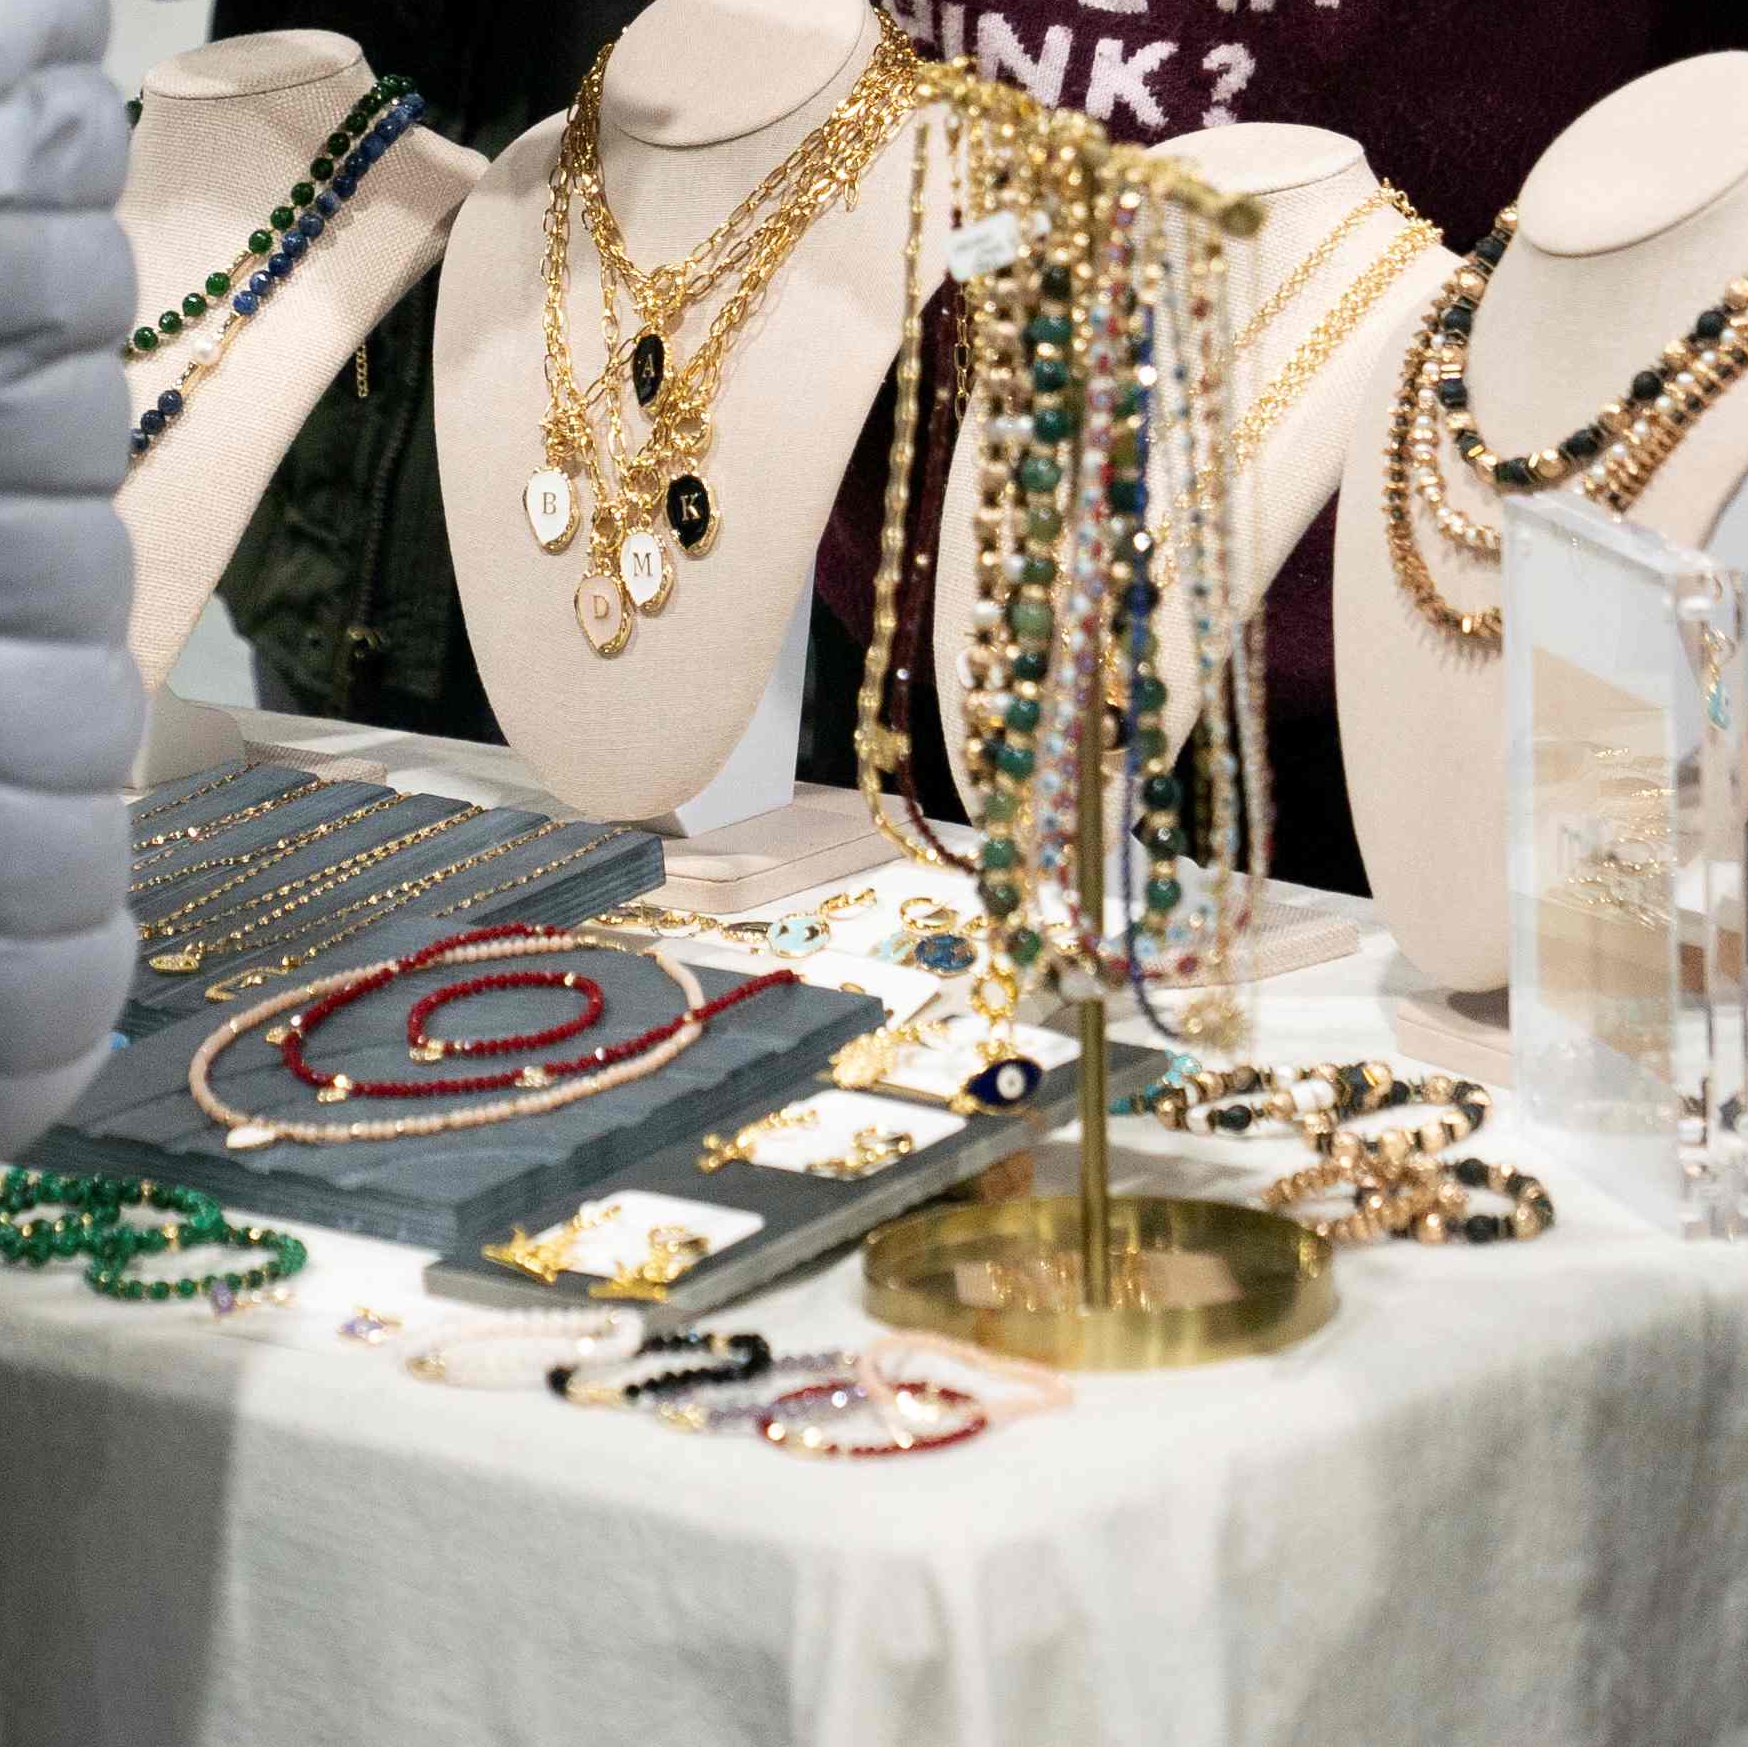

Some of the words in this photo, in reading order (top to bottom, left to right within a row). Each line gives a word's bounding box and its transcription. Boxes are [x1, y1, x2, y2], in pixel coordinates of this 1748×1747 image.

[642, 353, 656, 378] A
[541, 492, 557, 515] B
[680, 494, 702, 523] K
[632, 552, 654, 577] M
[593, 595, 609, 619] D
